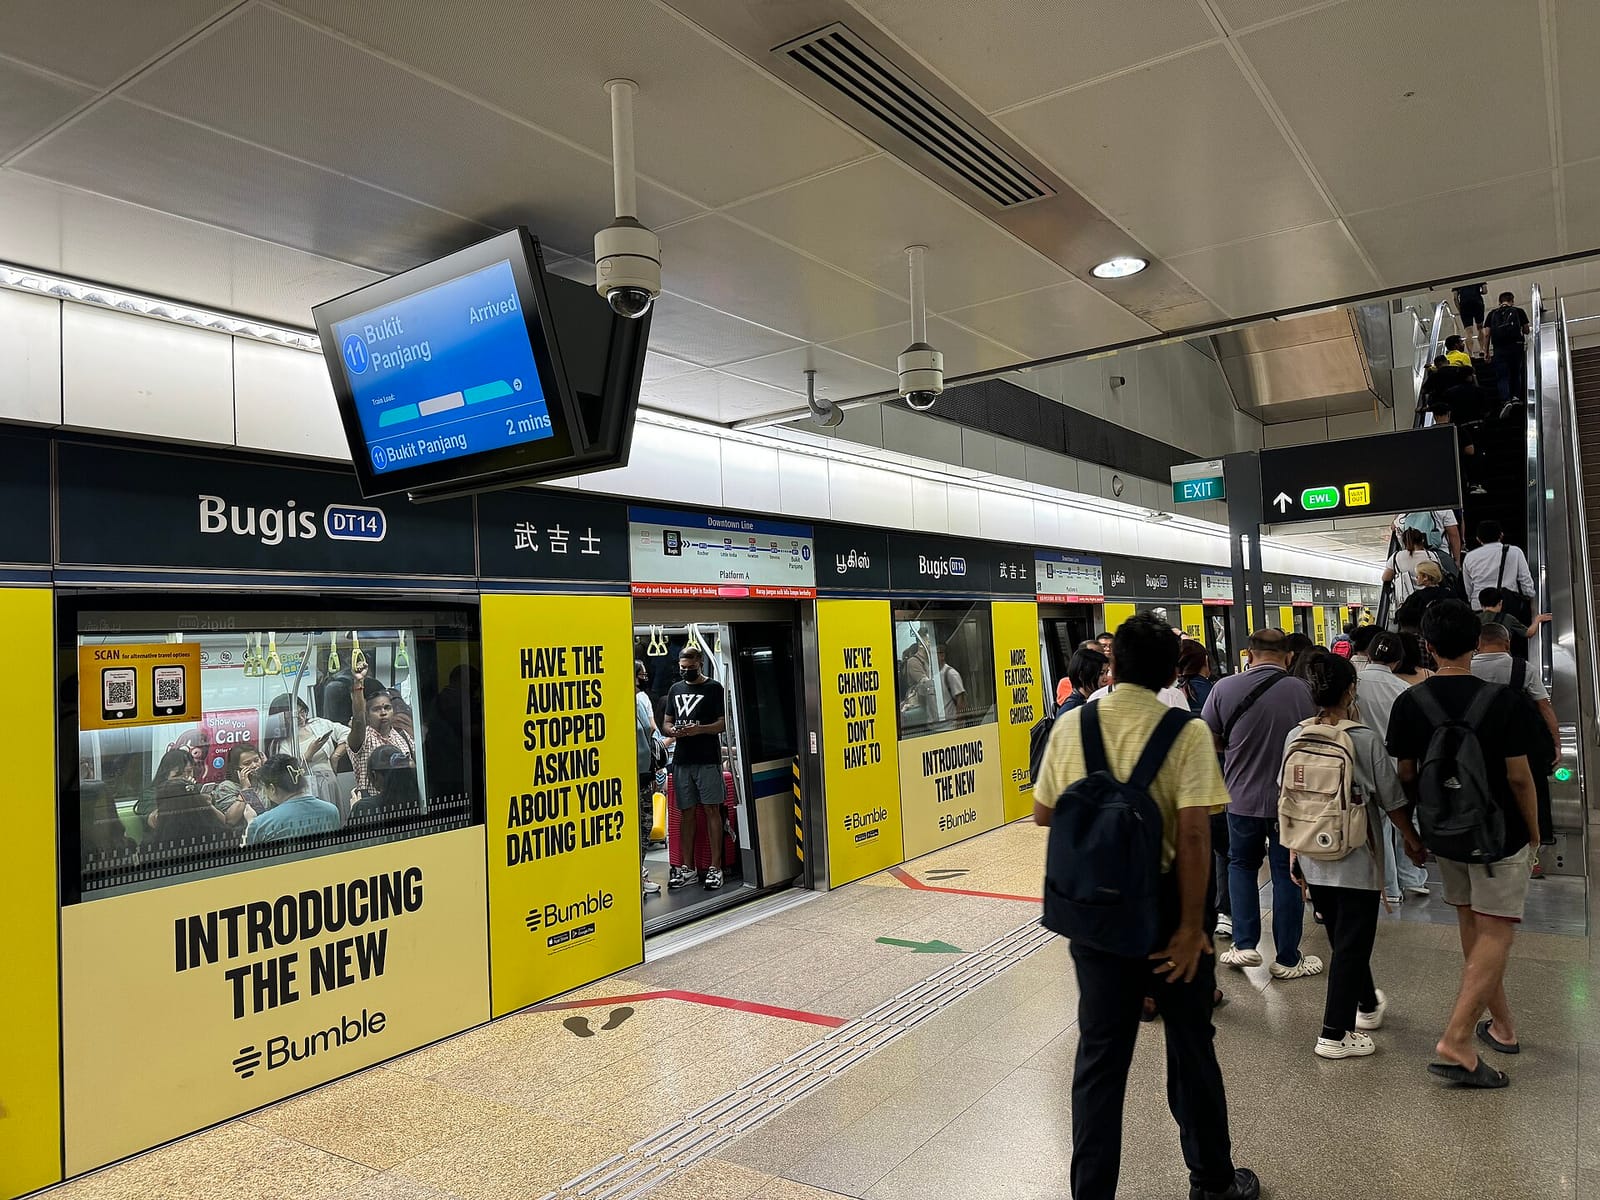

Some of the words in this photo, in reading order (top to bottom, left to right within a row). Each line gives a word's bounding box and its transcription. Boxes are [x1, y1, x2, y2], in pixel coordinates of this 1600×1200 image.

[469, 294, 517, 325] Arrived
[364, 318, 404, 345] Bukit
[346, 341, 366, 366] 11
[371, 339, 432, 372] Panjang
[506, 418, 516, 435] 2
[518, 413, 551, 433] mins
[374, 451, 384, 464] 11
[386, 440, 418, 462] Bukit
[418, 433, 467, 458] Panjang
[1183, 482, 1213, 499] EXIT
[1309, 493, 1331, 505] EWL
[199, 494, 317, 546] Bugis
[333, 513, 378, 533] DT14
[708, 516, 740, 528] Downtown
[740, 520, 754, 530] Line
[514, 521, 601, 555] 武吉士
[720, 570, 744, 580] Platform
[744, 572, 750, 580] A
[919, 556, 948, 579] Bugis
[950, 561, 965, 573] DT14
[999, 562, 1027, 580] 武吉士
[632, 586, 646, 594] Please
[1146, 574, 1160, 590] Bugis
[94, 650, 120, 660] SCAN
[520, 646, 568, 678] HAVE
[572, 646, 604, 675] THE
[844, 647, 872, 669] WE'VE
[1010, 649, 1026, 666] MORE
[838, 670, 880, 694] CHANGED
[1004, 668, 1034, 687] FEATURES,
[526, 679, 602, 715] AUNTIES
[675, 694, 704, 717] W
[844, 698, 856, 719] SO
[858, 695, 876, 716] YOU
[1012, 687, 1028, 705] MORE
[210, 718, 230, 727] Show
[232, 720, 246, 728] You
[1010, 706, 1034, 725] CHOICES
[216, 730, 250, 744] Care
[524, 713, 606, 751] STOPPED
[848, 719, 874, 744] DON'T
[533, 747, 600, 786] ASKING
[844, 745, 868, 770] HAVE
[868, 743, 880, 764] TO
[922, 740, 983, 777] INTRODUCING
[1018, 768, 1031, 780] Bum
[935, 776, 954, 803] THE
[955, 770, 975, 797] NEW
[507, 787, 571, 829] ABOUT
[578, 777, 622, 814] YOUR
[852, 806, 887, 828] Bumble
[946, 808, 976, 830] Bumble
[506, 822, 576, 867] DATING
[580, 810, 624, 850] LIFE?
[175, 867, 423, 973] INTRODUCING
[544, 890, 613, 928] Bumble
[225, 952, 300, 1020] THE
[310, 928, 388, 996] NEW
[268, 1009, 386, 1071] Bumble
